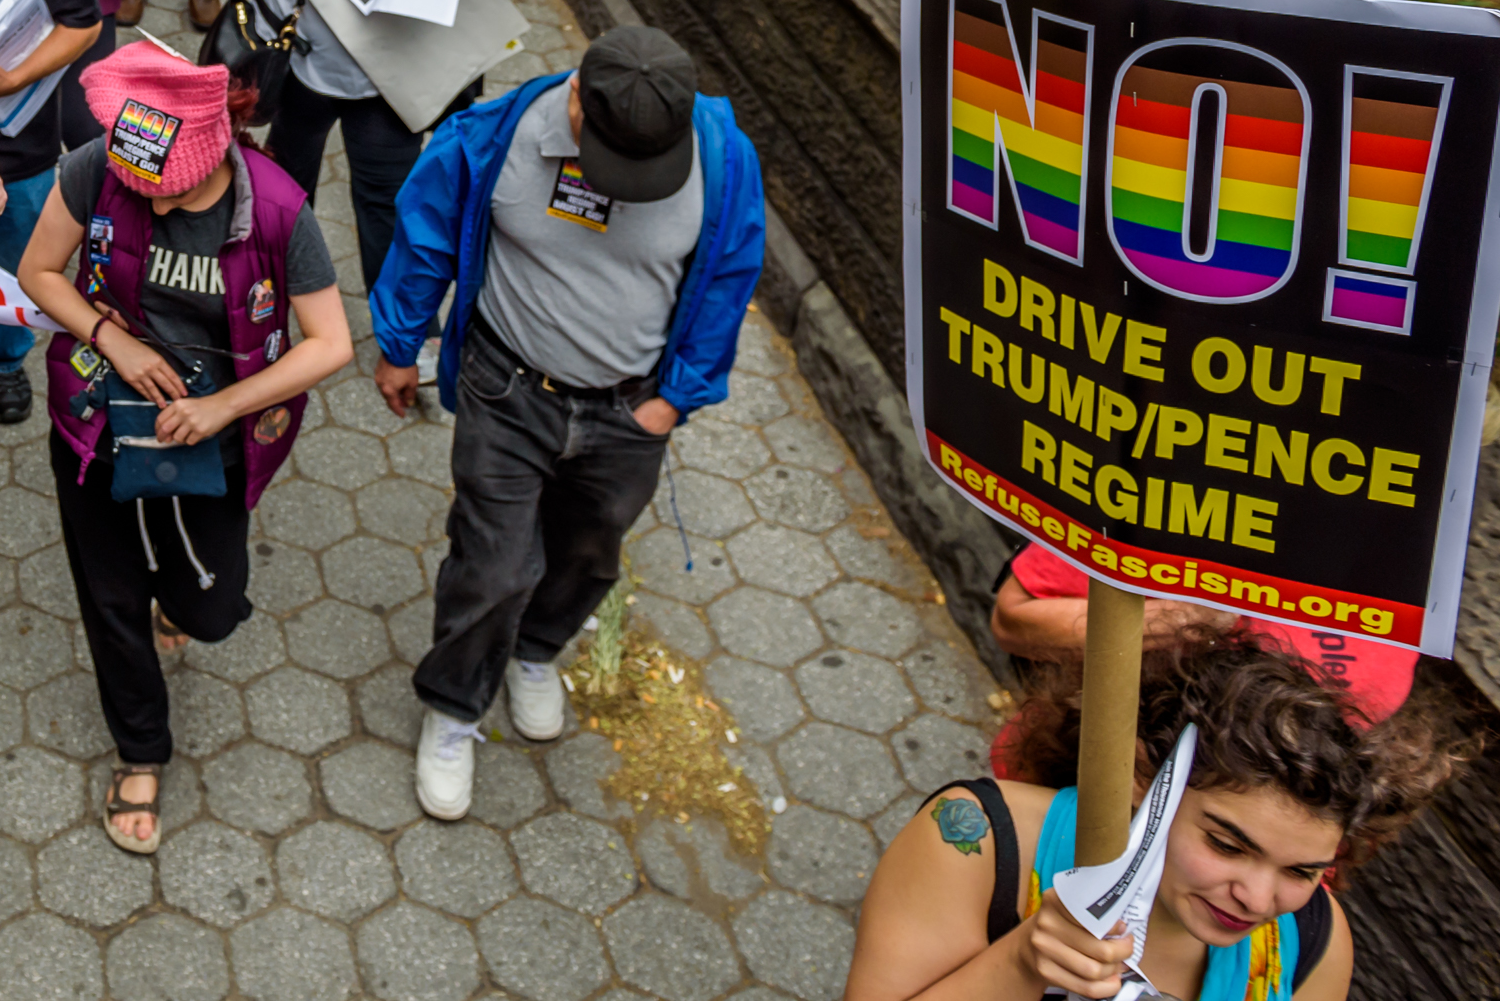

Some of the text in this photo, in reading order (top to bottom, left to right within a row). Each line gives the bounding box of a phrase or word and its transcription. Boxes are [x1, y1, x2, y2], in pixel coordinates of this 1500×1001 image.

[117, 100, 179, 147] NO!
[114, 127, 166, 157] TRUMP/PENCE
[122, 141, 152, 161] REGIME
[111, 144, 140, 165] MUST
[138, 158, 160, 174] GO!
[983, 258, 1362, 416] DRIVE OUT
[940, 306, 1421, 508] TRUMP/PENCE
[1021, 419, 1279, 554] REGIME
[940, 443, 1394, 636] RefuseFascism.org
[1163, 772, 1171, 783] the
[1156, 783, 1170, 817] Thousands
[1152, 817, 1161, 833] Who
[1143, 832, 1154, 849] Have
[1132, 849, 1147, 871] Signed
